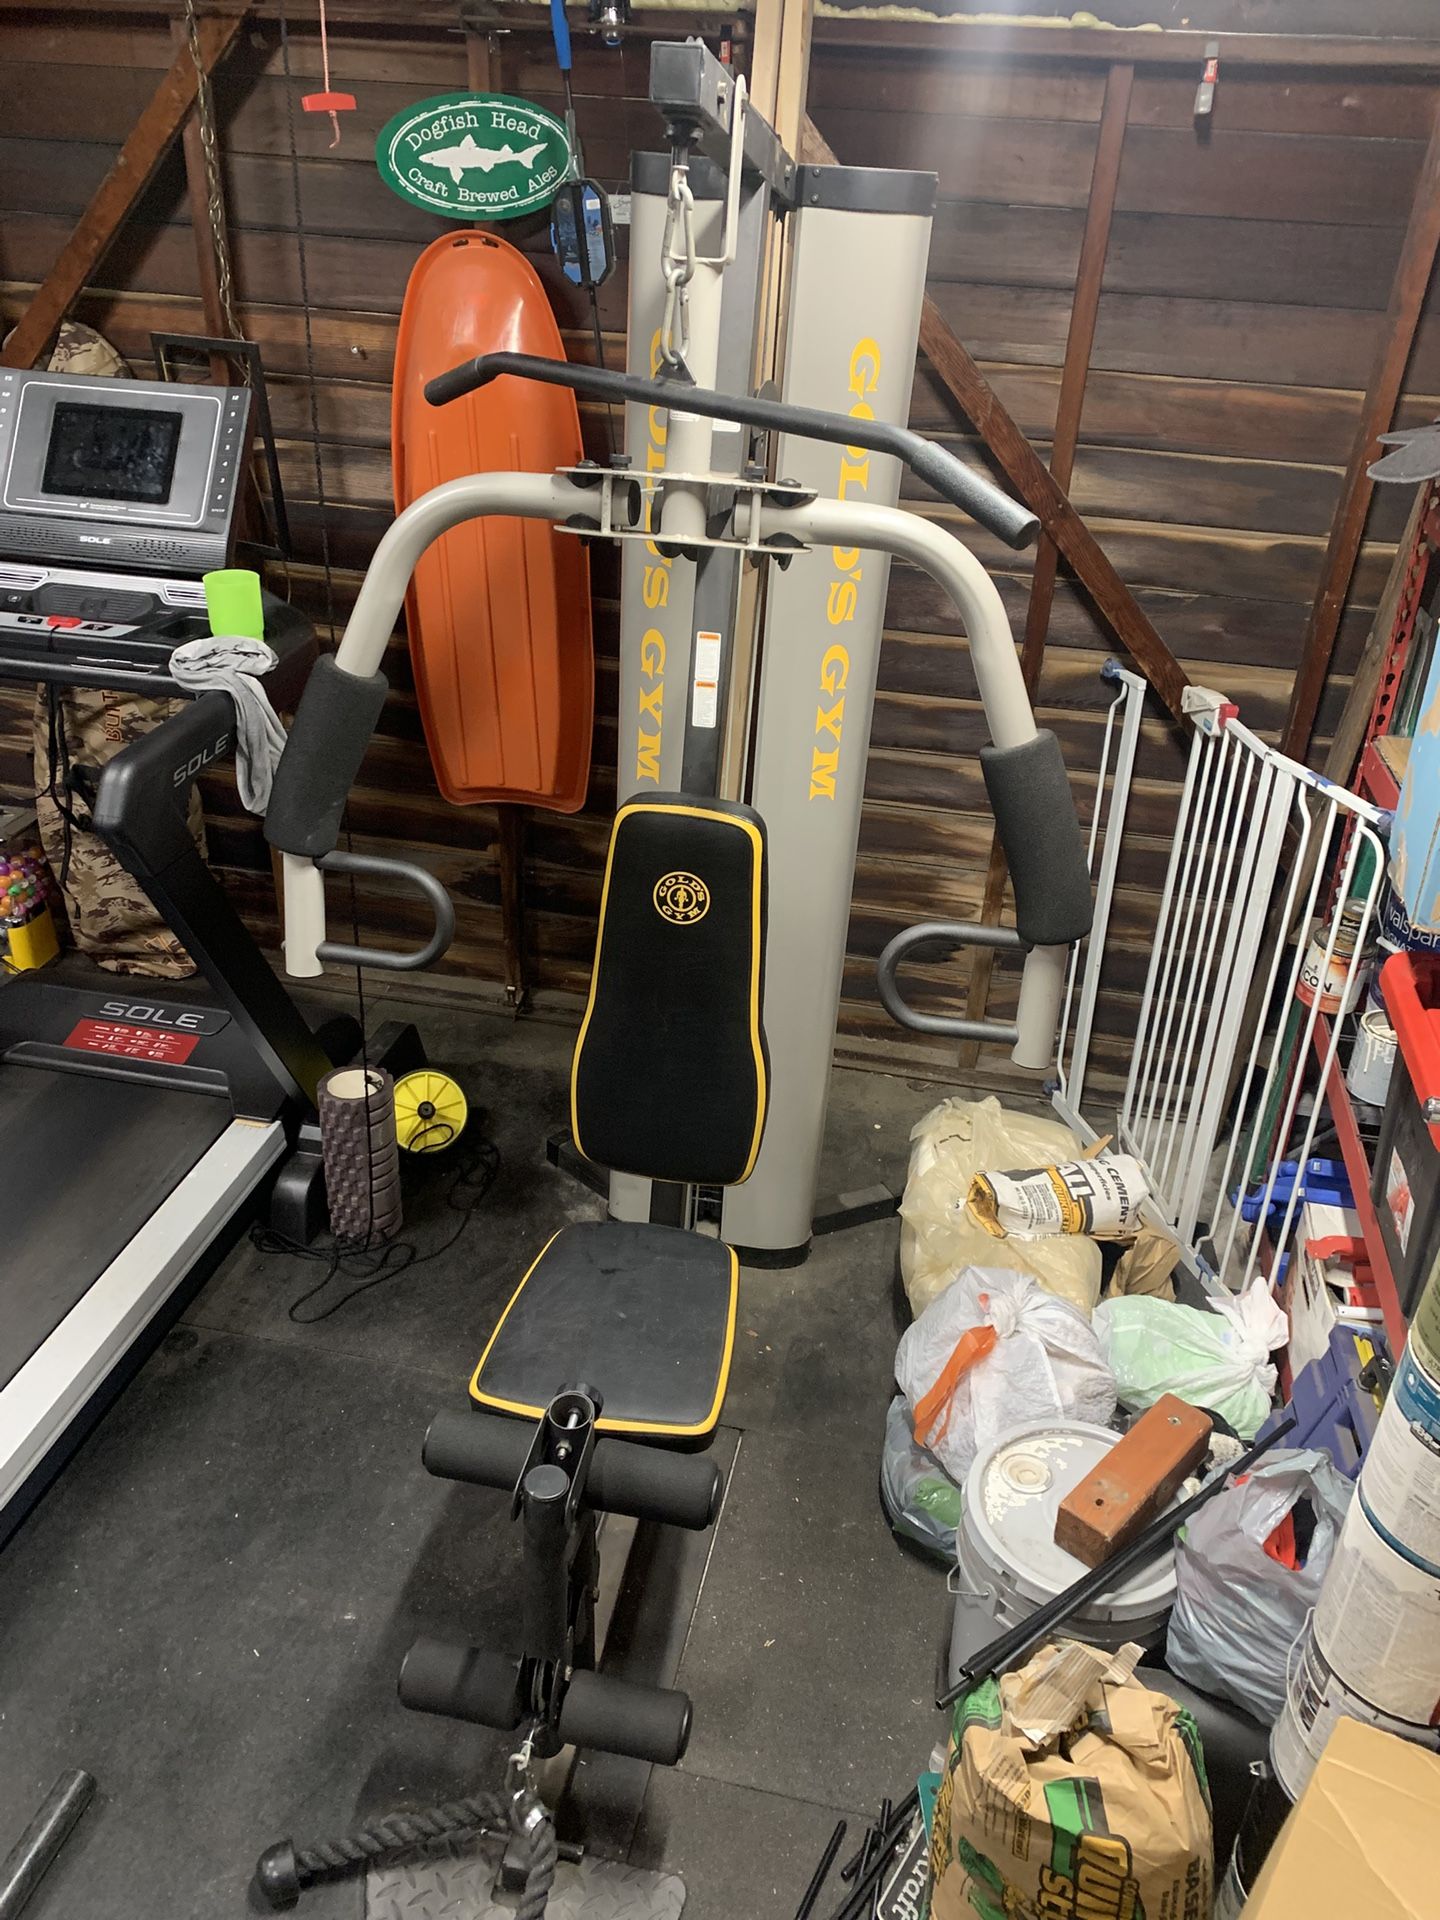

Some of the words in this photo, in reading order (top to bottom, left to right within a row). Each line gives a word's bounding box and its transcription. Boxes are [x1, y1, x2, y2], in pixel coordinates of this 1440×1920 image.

[405, 112, 480, 151] Dogfish
[490, 112, 541, 140] Head
[408, 167, 449, 198] Craft
[457, 188, 520, 203] Brewed
[528, 164, 558, 194] Ales
[79, 535, 111, 545] SOLE
[636, 628, 666, 785] GYM
[809, 644, 850, 801] GYM
[173, 732, 229, 788] SOLE
[659, 875, 705, 901] GOLD'S
[662, 905, 701, 920] GYM
[1390, 905, 1440, 948] valspar
[99, 1001, 205, 1028] SOLE
[1107, 1167, 1130, 1224] CEMENT
[892, 1846, 931, 1920] raft
